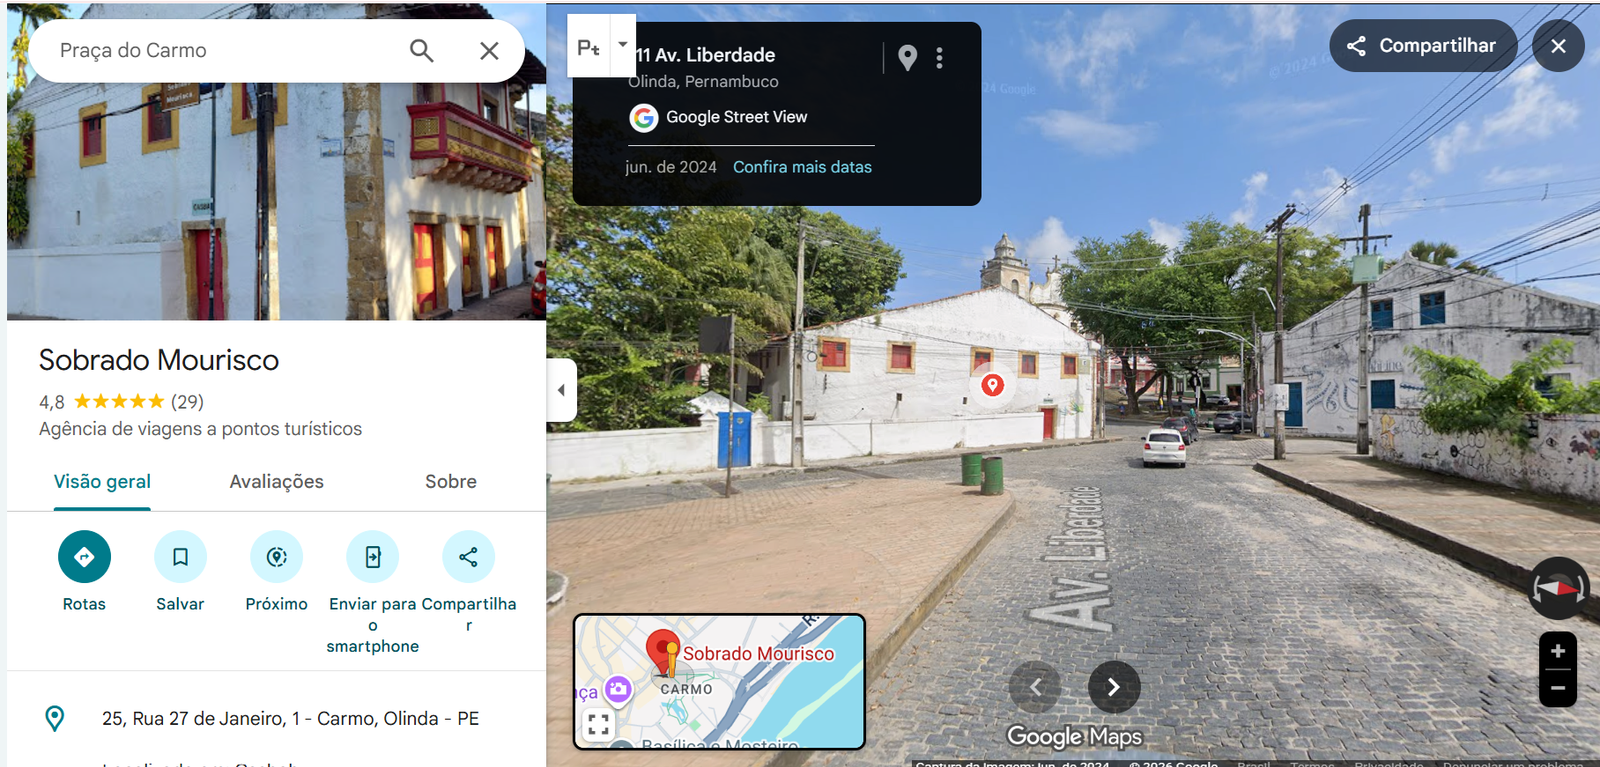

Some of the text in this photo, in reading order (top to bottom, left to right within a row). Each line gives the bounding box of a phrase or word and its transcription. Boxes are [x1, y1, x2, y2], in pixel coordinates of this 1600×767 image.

[61, 42, 206, 62] Praça do Carmo
[39, 348, 279, 371] Sobrado Mourisco
[39, 395, 64, 411] 4,8
[172, 394, 203, 411] (29)
[39, 421, 362, 439] Agência de viagens a pontos turísticos
[54, 473, 150, 492] Visão geral
[230, 474, 324, 493] Avaliações
[426, 474, 477, 488] Sobre
[63, 598, 106, 610] Rotas
[157, 597, 205, 610] Salvar
[246, 597, 308, 610] Próximo
[330, 597, 416, 613] Enviar para
[422, 597, 516, 613] Compartilha
[368, 622, 377, 631] o
[467, 622, 472, 631] r
[327, 639, 419, 656] smartphone
[103, 711, 126, 727] 25,
[134, 712, 163, 725] Rua
[170, 711, 188, 725] 27
[194, 711, 215, 725] de
[219, 711, 286, 727] Janeiro,
[293, 712, 298, 725] 1
[318, 711, 378, 727] Carmo,
[384, 711, 438, 725] Olinda
[458, 711, 479, 725] PE
